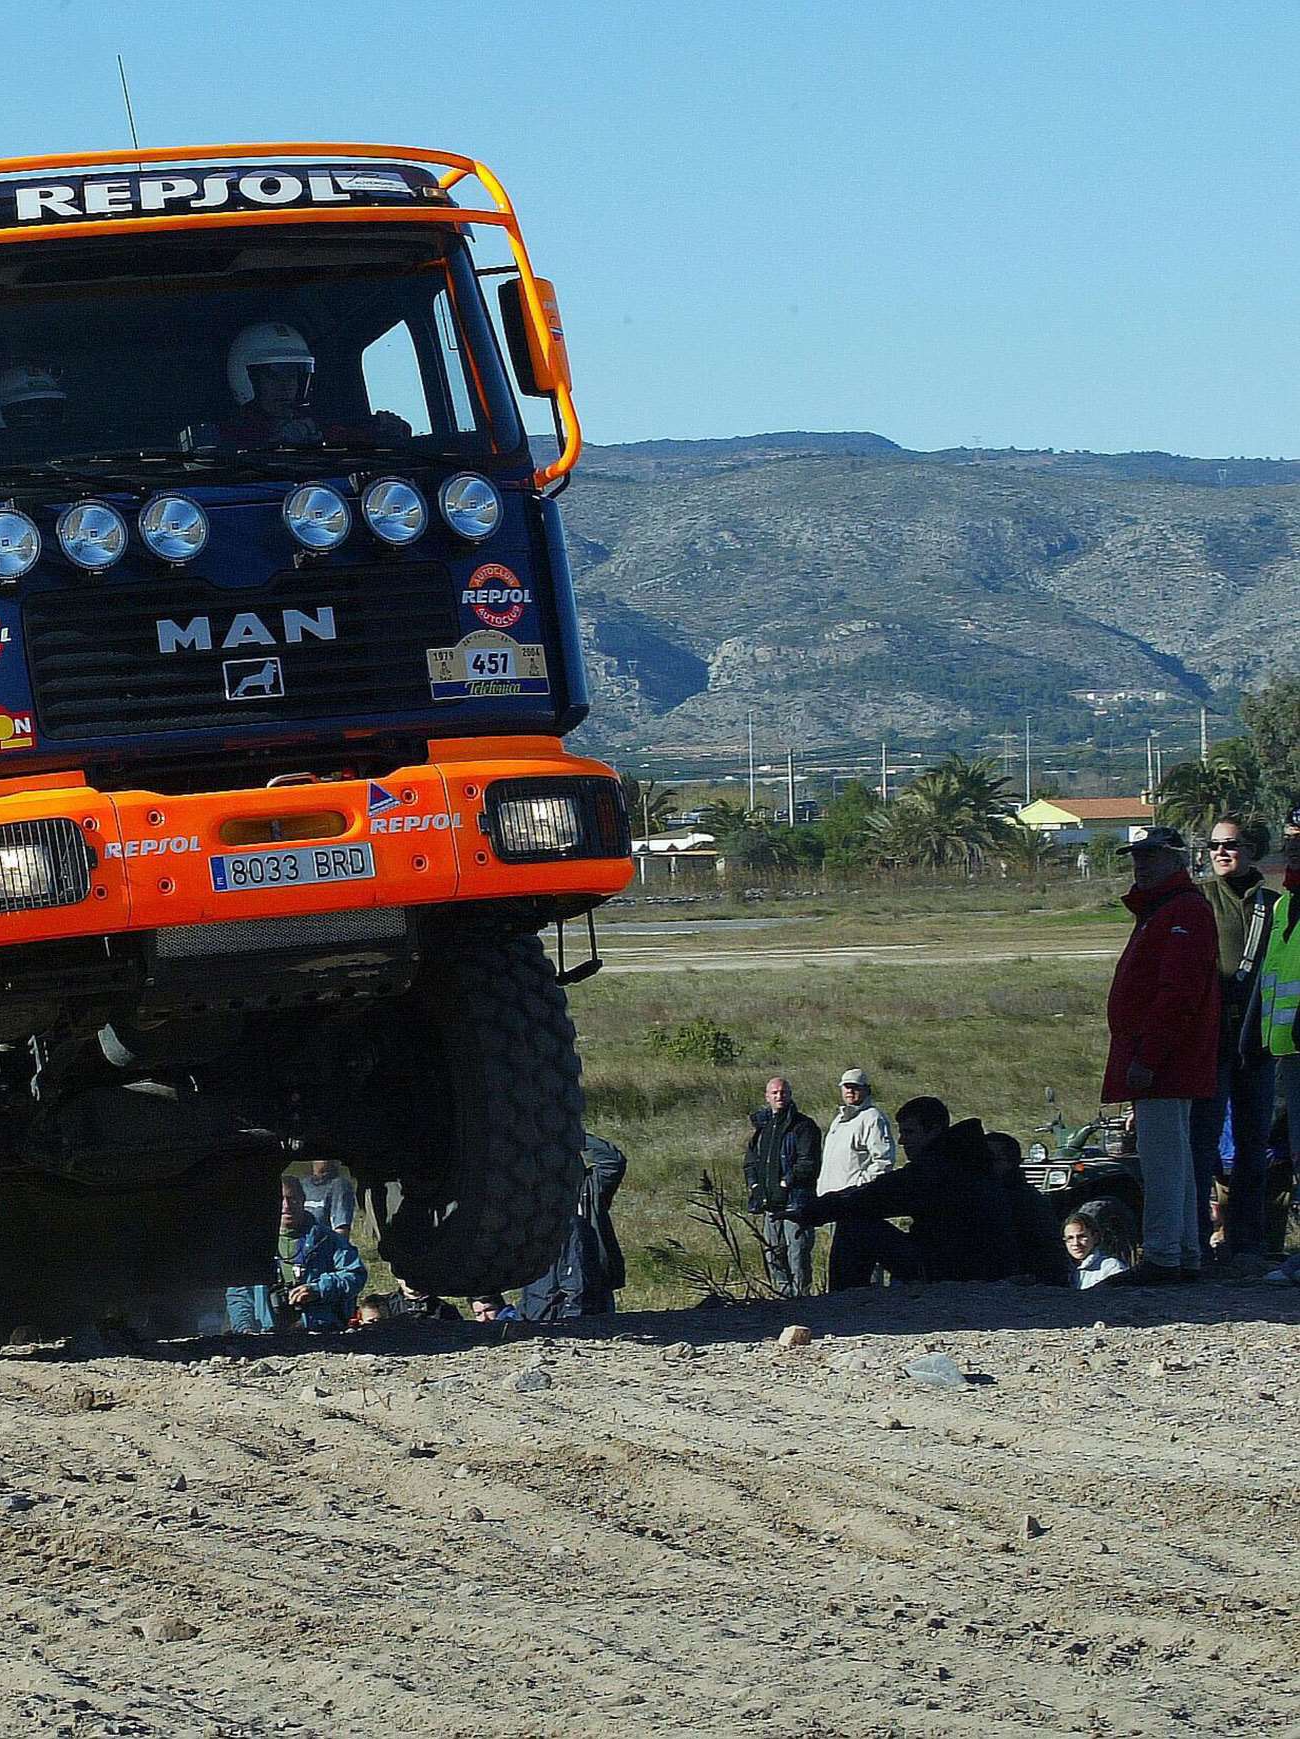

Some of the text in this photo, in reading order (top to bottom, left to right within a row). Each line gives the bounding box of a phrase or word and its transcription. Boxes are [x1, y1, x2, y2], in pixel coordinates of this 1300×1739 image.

[15, 169, 351, 221] REPSOL
[461, 589, 533, 604] REPSOL
[476, 604, 521, 625] AUTOCLUB
[156, 606, 337, 654] MAN
[472, 652, 509, 676] 451
[370, 812, 464, 835] REPSOL
[103, 834, 202, 860] REPSOL
[231, 847, 366, 886] 8033 BRD
